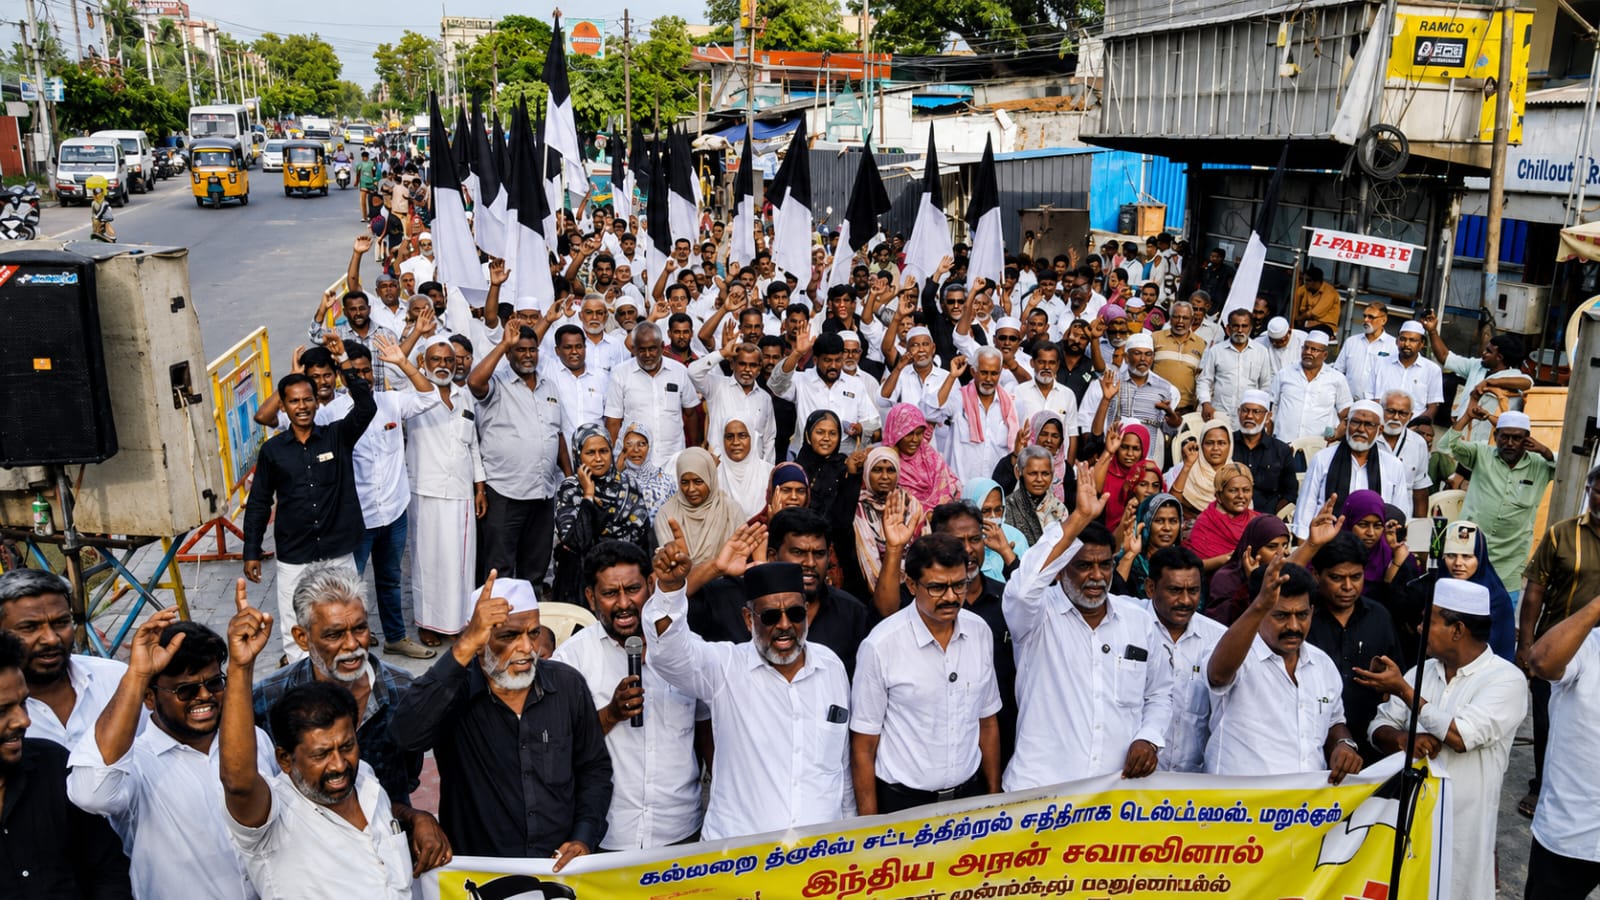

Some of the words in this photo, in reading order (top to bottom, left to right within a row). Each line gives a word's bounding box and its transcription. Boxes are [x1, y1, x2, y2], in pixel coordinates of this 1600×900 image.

[1419, 20, 1464, 33] RAMCO
[1517, 158, 1574, 182] Chillout
[801, 857, 935, 900] இந்திய
[1062, 835, 1264, 864] சவாலினால்
